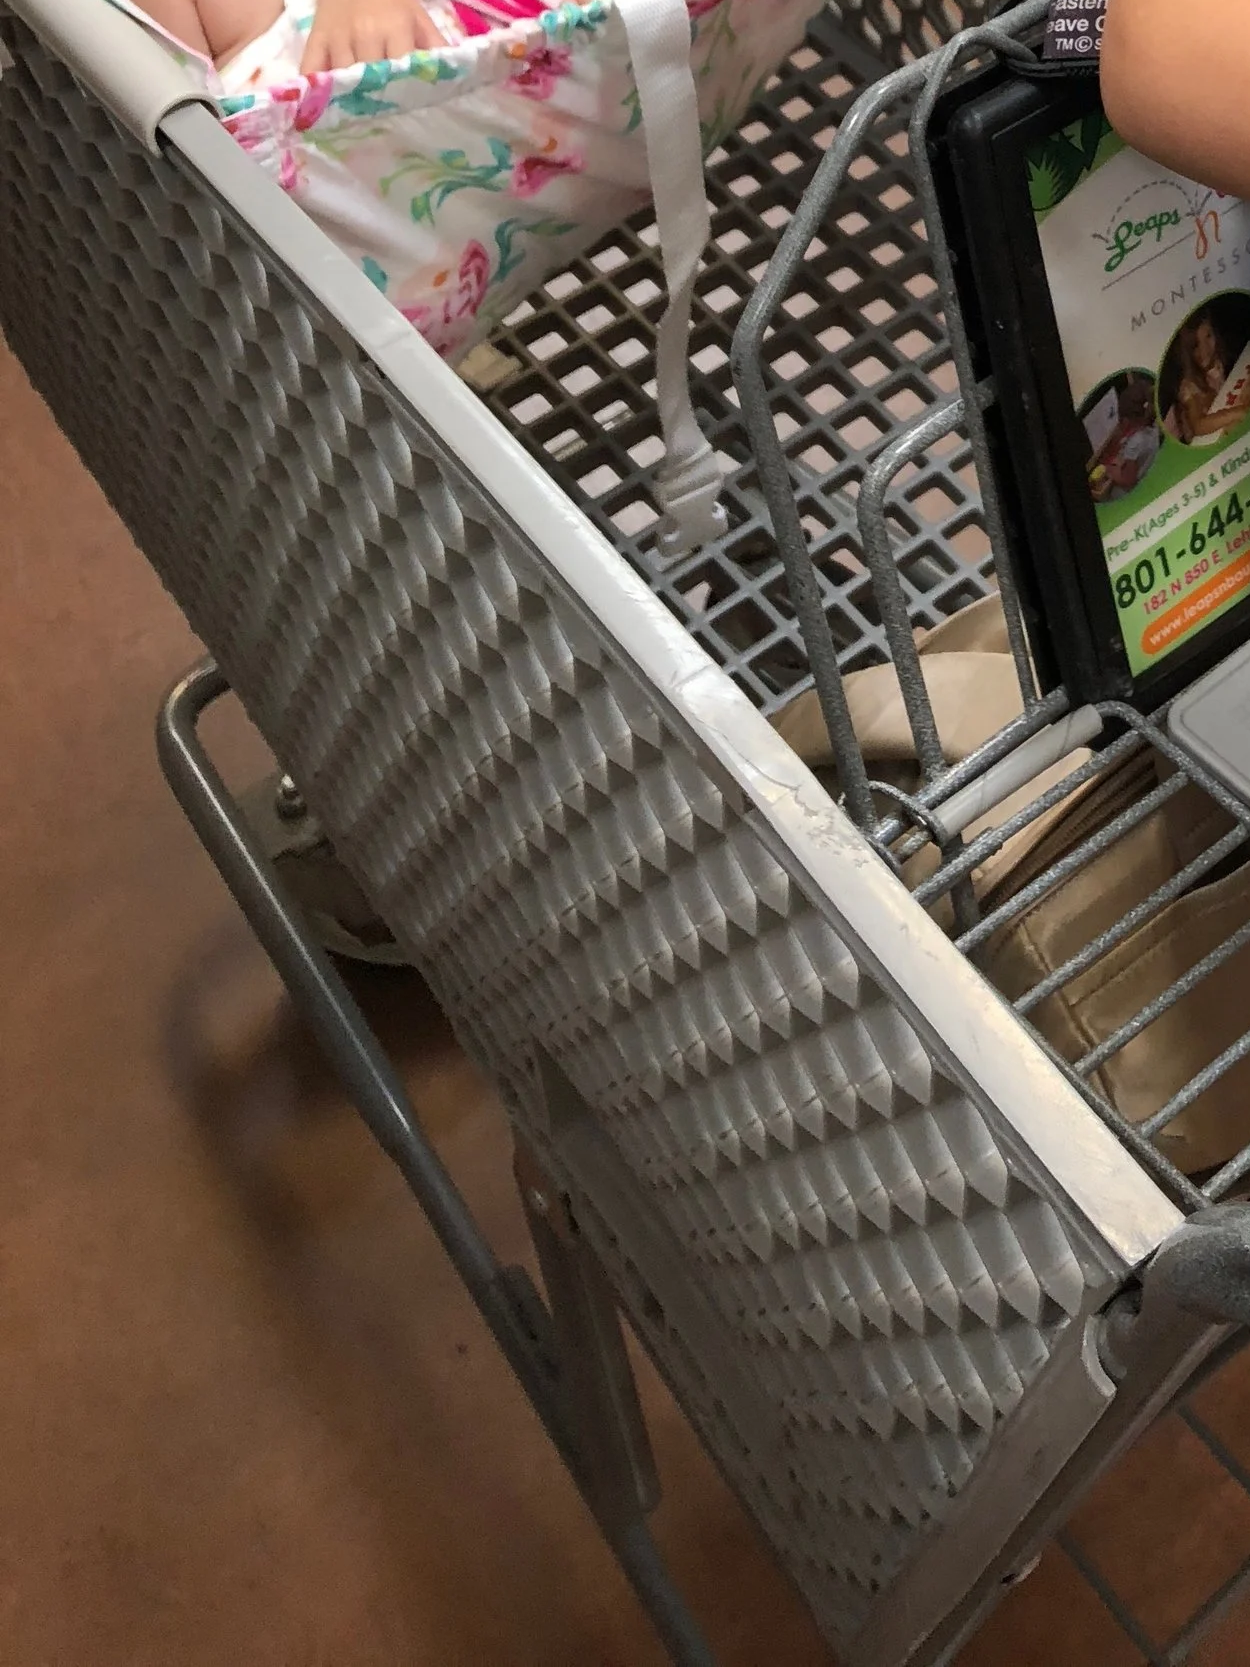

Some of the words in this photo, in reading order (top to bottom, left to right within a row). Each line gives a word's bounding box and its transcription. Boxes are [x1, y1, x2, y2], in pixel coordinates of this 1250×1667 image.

[1046, 17, 1089, 33] eave
[1104, 209, 1181, 272] Leaps
[1143, 588, 1168, 615] 182
[1171, 578, 1182, 596] N
[1184, 558, 1209, 585] 850
